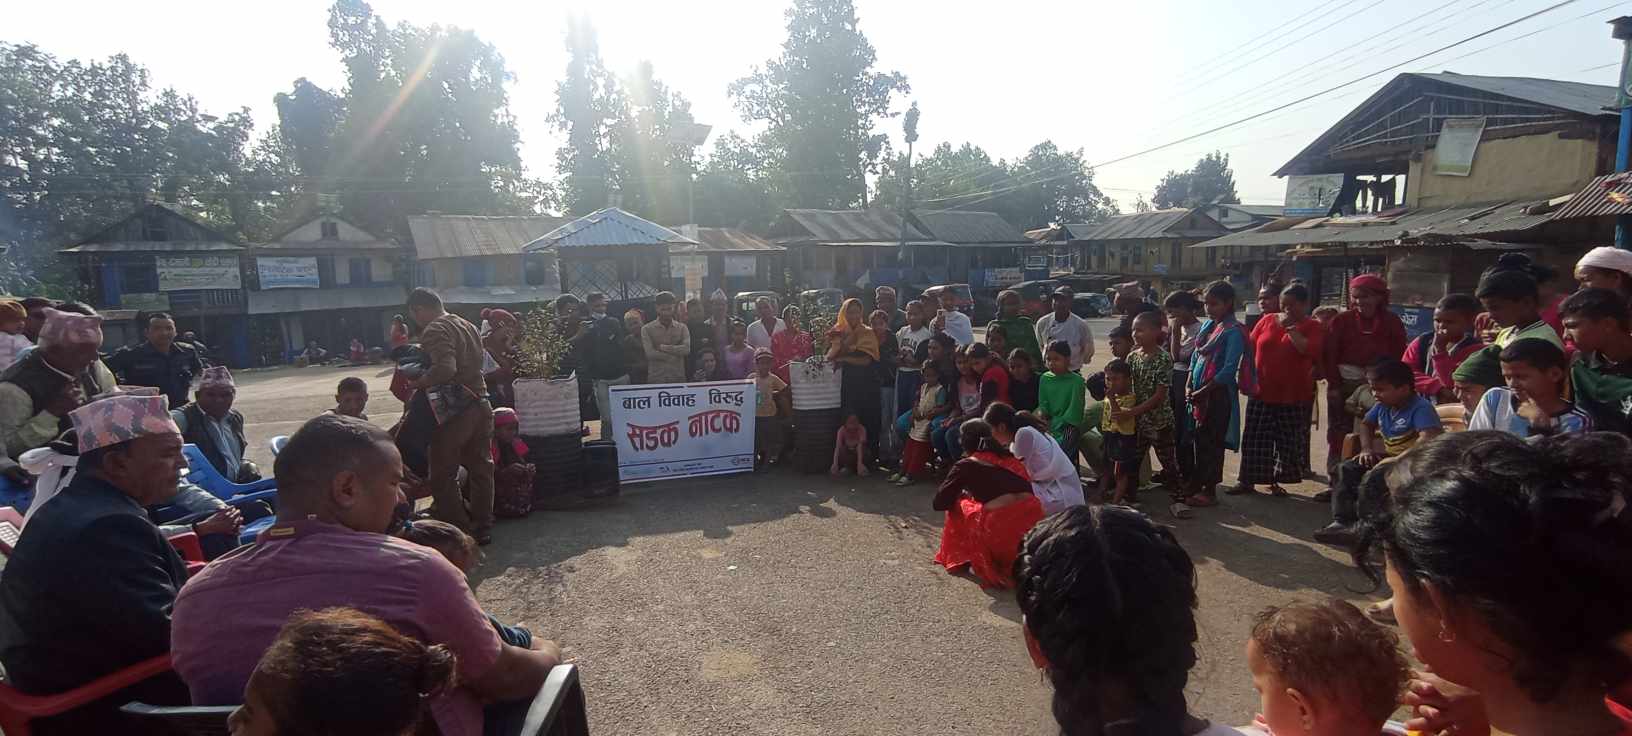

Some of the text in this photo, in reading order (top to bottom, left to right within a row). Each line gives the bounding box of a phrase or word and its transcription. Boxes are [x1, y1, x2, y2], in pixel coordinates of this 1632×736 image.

[622, 396, 651, 410] बाल
[658, 391, 696, 408] विवाह
[626, 409, 742, 452] सडक नाटक
